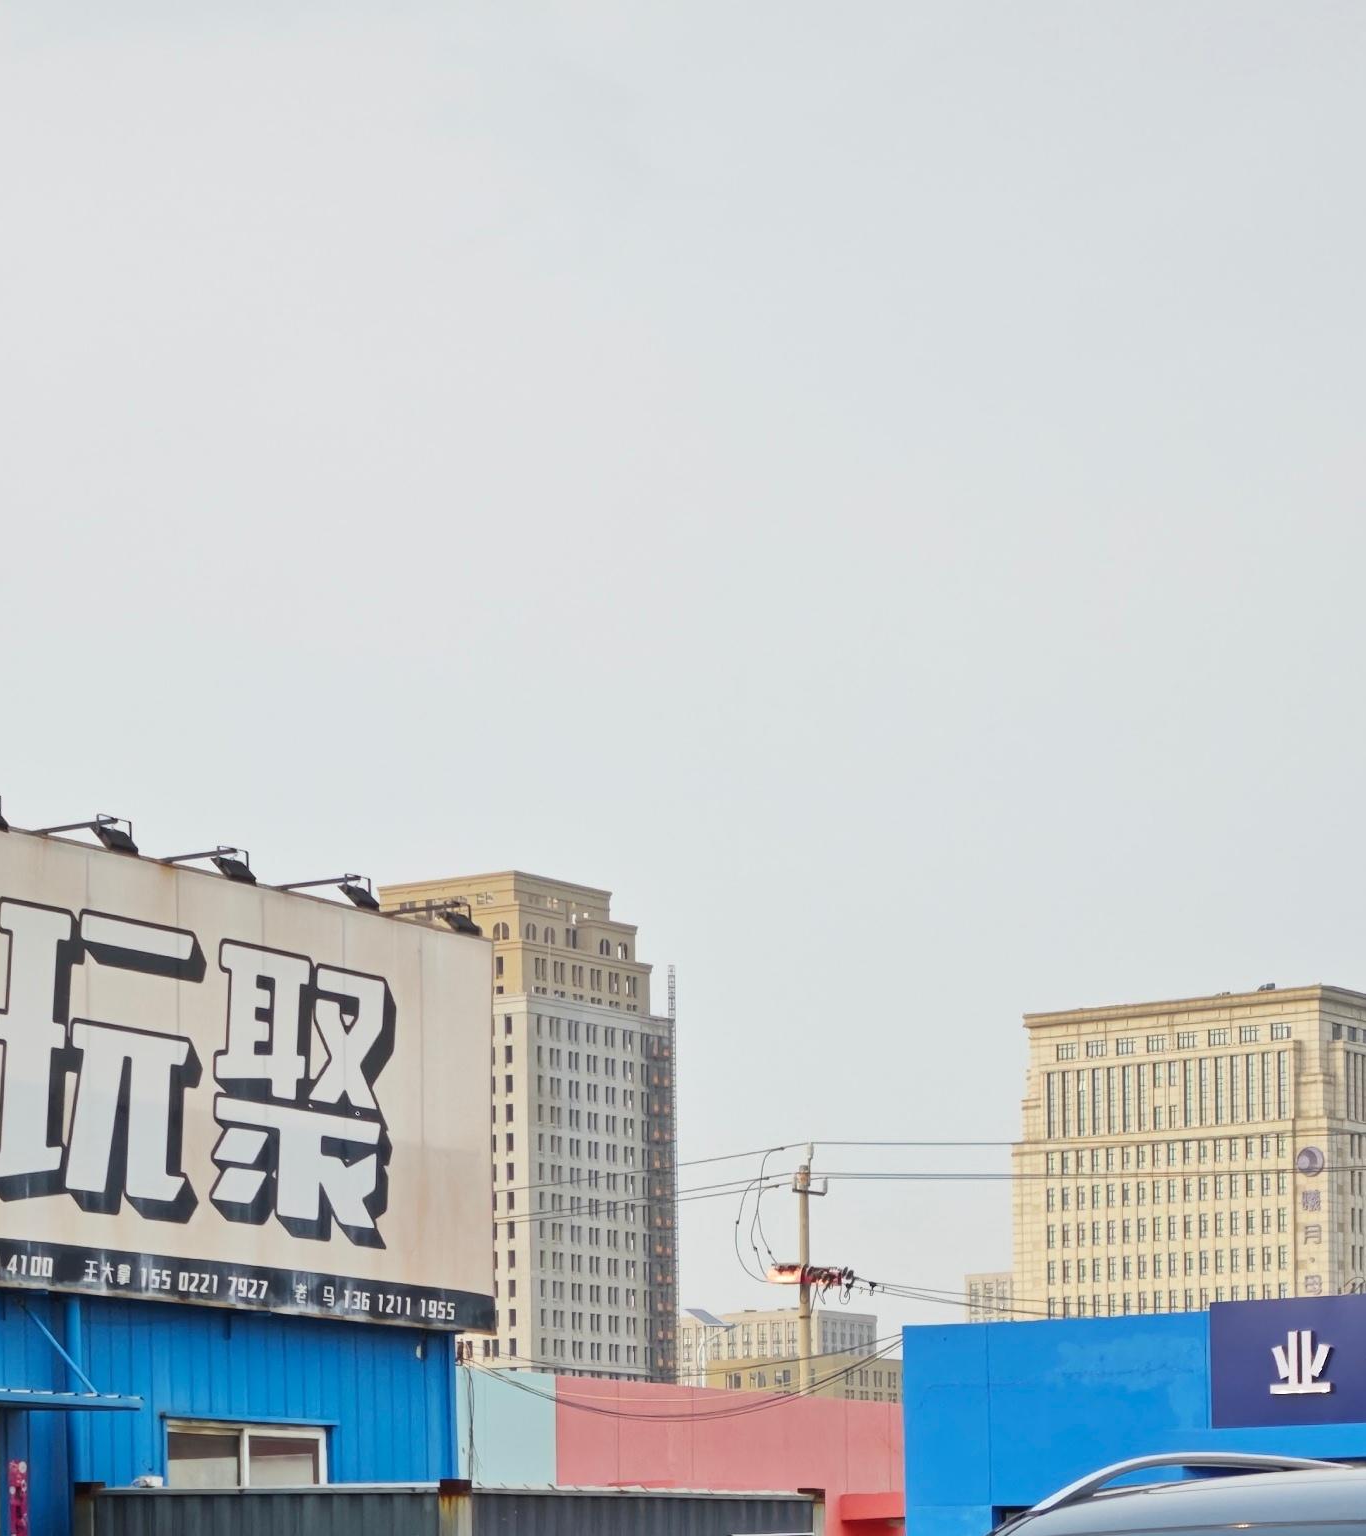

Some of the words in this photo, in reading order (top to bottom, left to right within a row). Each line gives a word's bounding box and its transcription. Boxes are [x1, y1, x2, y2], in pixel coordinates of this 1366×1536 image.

[7, 1254, 54, 1278] 4100
[178, 1271, 218, 1294] 0221
[228, 1276, 268, 1300] 7927
[344, 1289, 371, 1311] 136
[378, 1293, 411, 1316] 1211
[420, 1298, 456, 1320] 1955
